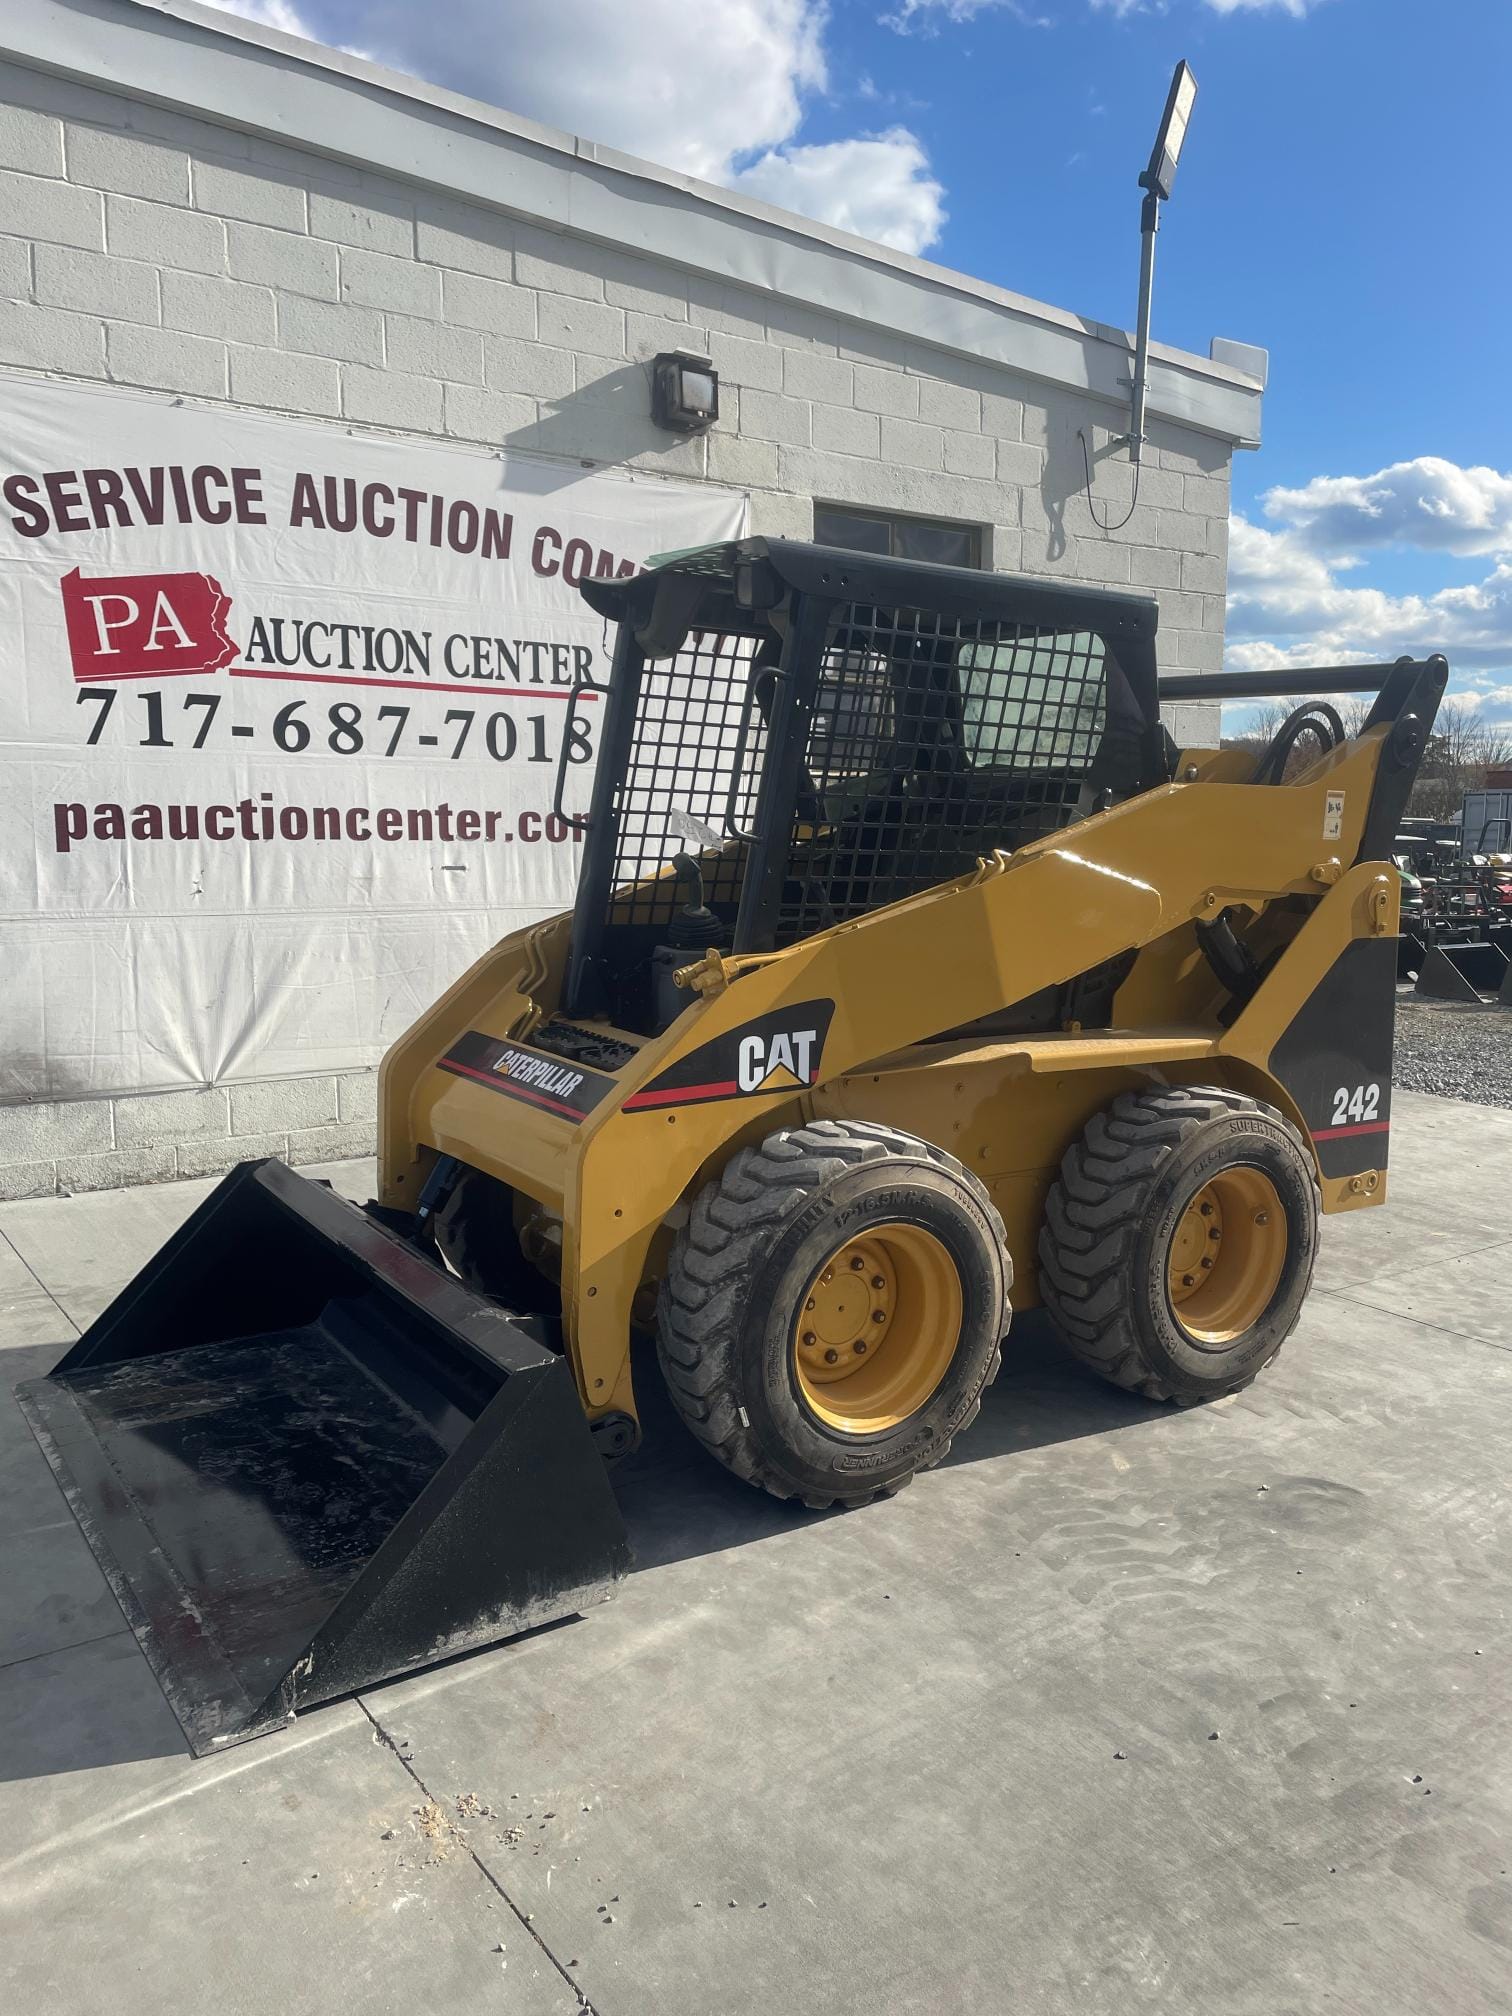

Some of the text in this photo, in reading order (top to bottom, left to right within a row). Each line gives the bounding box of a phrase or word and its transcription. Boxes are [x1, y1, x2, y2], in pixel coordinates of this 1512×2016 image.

[3, 465, 649, 589] SERVICE AUCTION COM
[83, 590, 198, 656] PA
[244, 616, 596, 686] AUCTION CENTER
[75, 687, 594, 765] 717-687-7018
[492, 1050, 584, 1098] CATERPILLAR
[738, 1030, 817, 1092] CAT
[1331, 1083, 1380, 1126] 242
